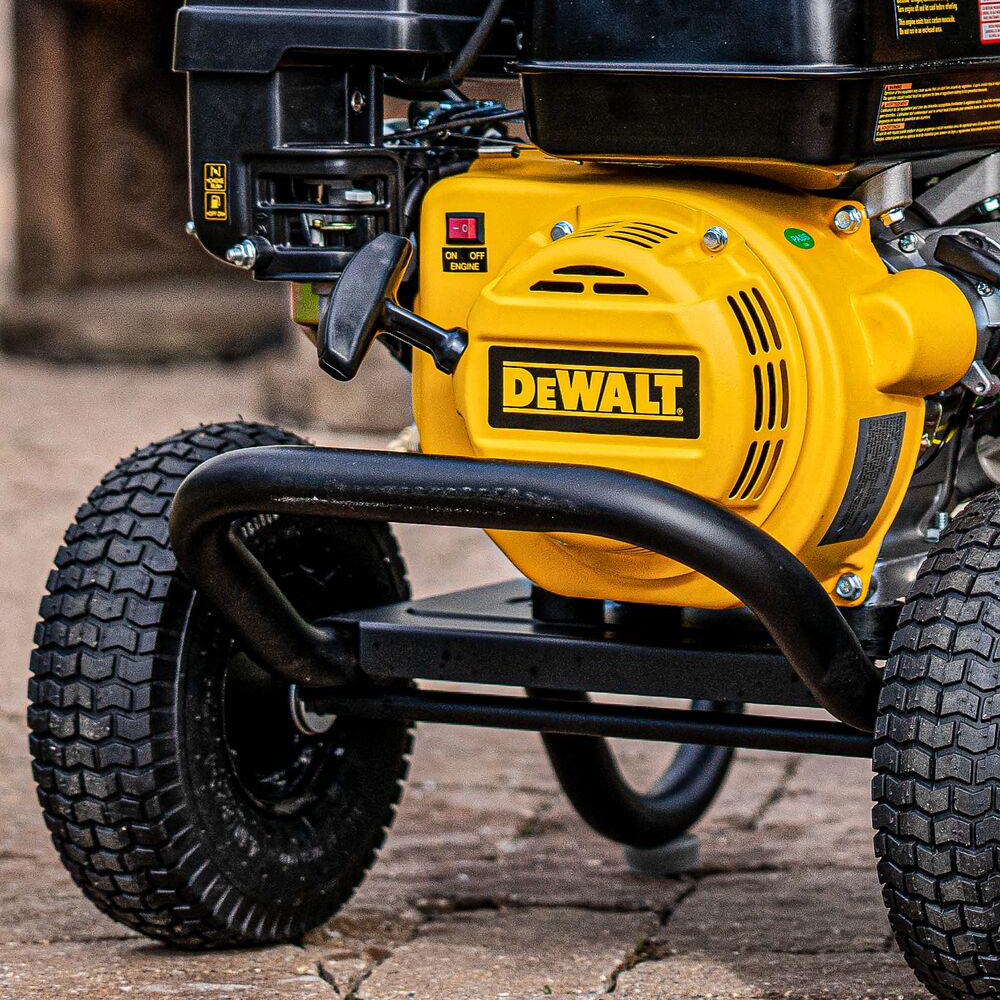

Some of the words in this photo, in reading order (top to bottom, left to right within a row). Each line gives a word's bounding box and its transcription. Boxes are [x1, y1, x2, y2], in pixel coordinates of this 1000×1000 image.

[445, 251, 458, 260] ON
[469, 251, 486, 260] OFF
[450, 262, 480, 271] ENGINE
